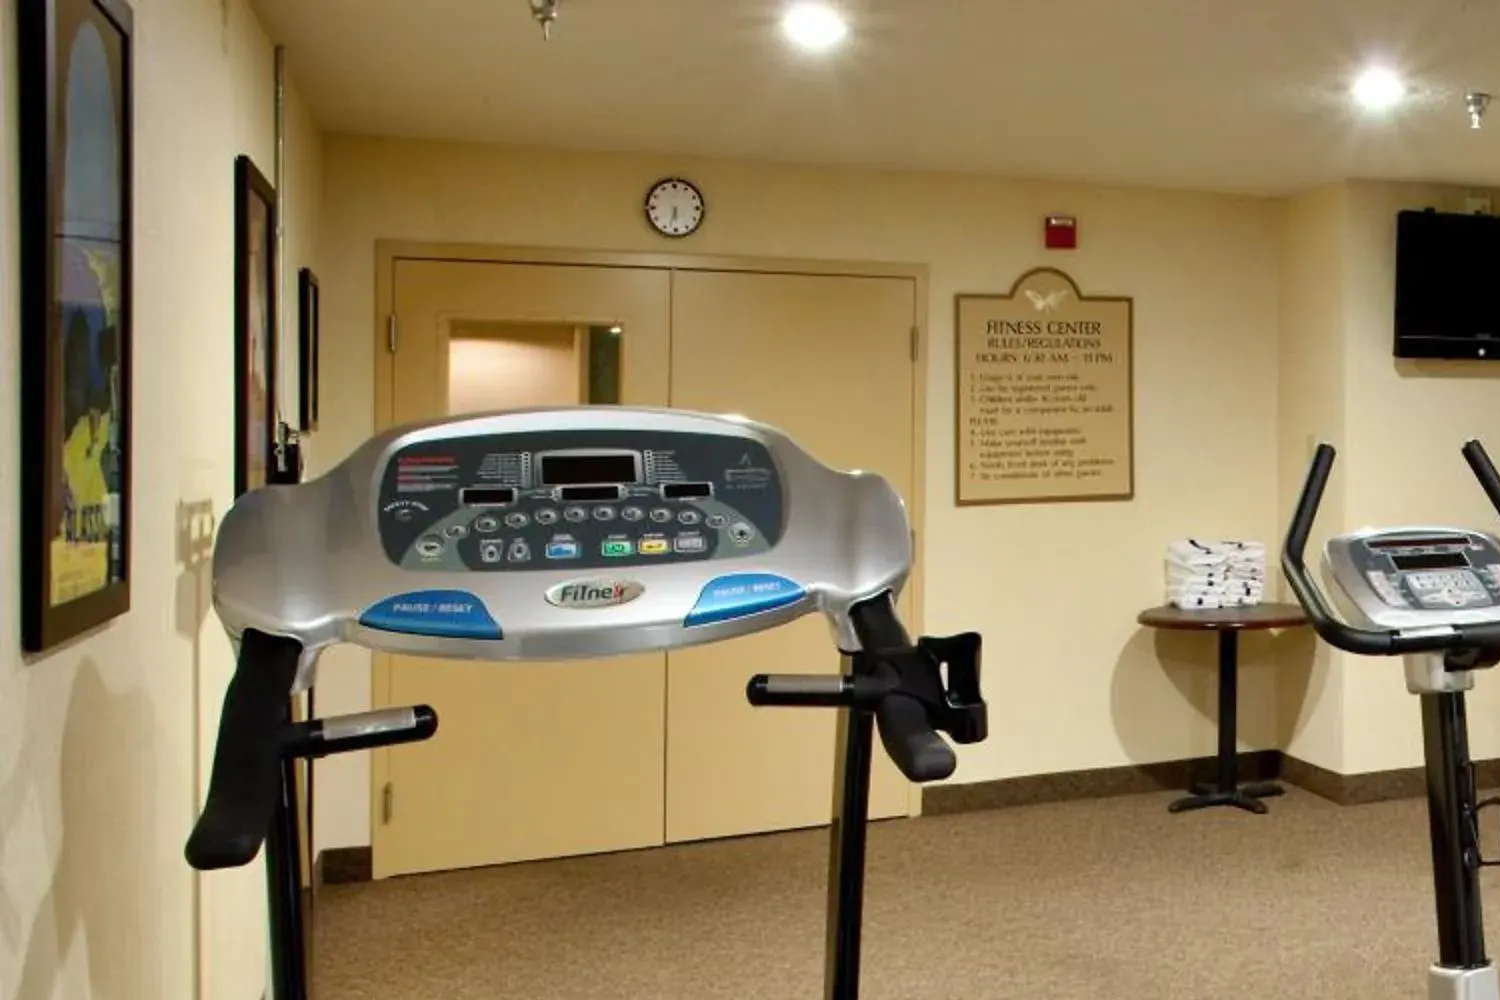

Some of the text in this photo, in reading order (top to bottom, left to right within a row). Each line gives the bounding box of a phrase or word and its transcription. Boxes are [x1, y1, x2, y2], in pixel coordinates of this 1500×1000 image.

[986, 320, 1101, 335] FITNESS CENTER
[393, 603, 429, 613] PAUSE
[438, 603, 473, 613] RESET
